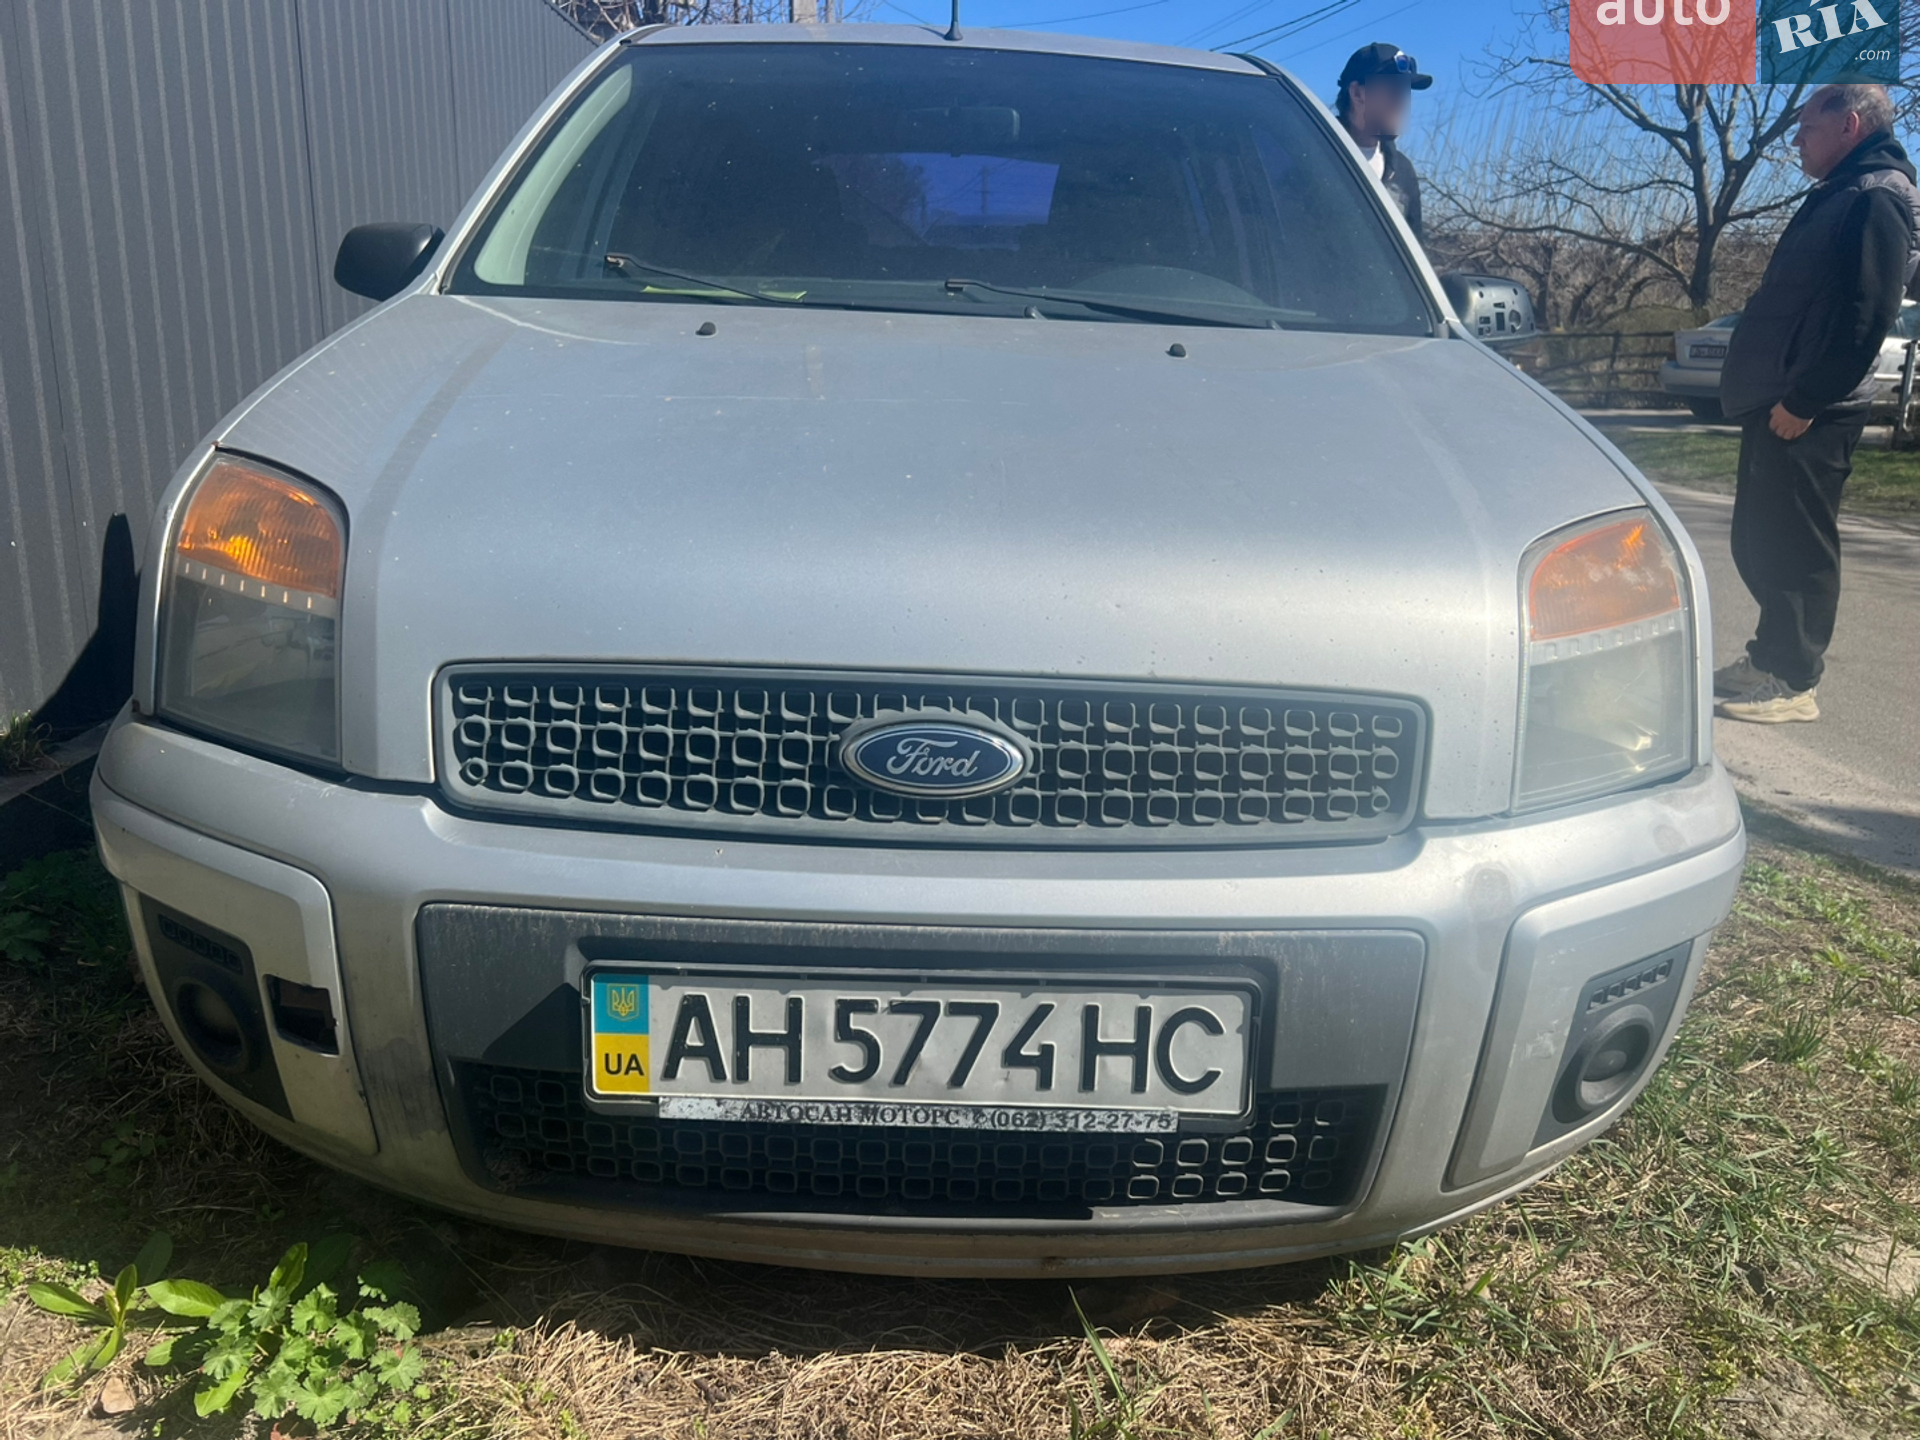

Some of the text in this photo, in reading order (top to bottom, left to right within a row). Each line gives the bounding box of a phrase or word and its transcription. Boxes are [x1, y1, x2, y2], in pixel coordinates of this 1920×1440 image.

[886, 737, 980, 777] Ford
[829, 998, 1056, 1090] 5774
[604, 1053, 645, 1076] UA
